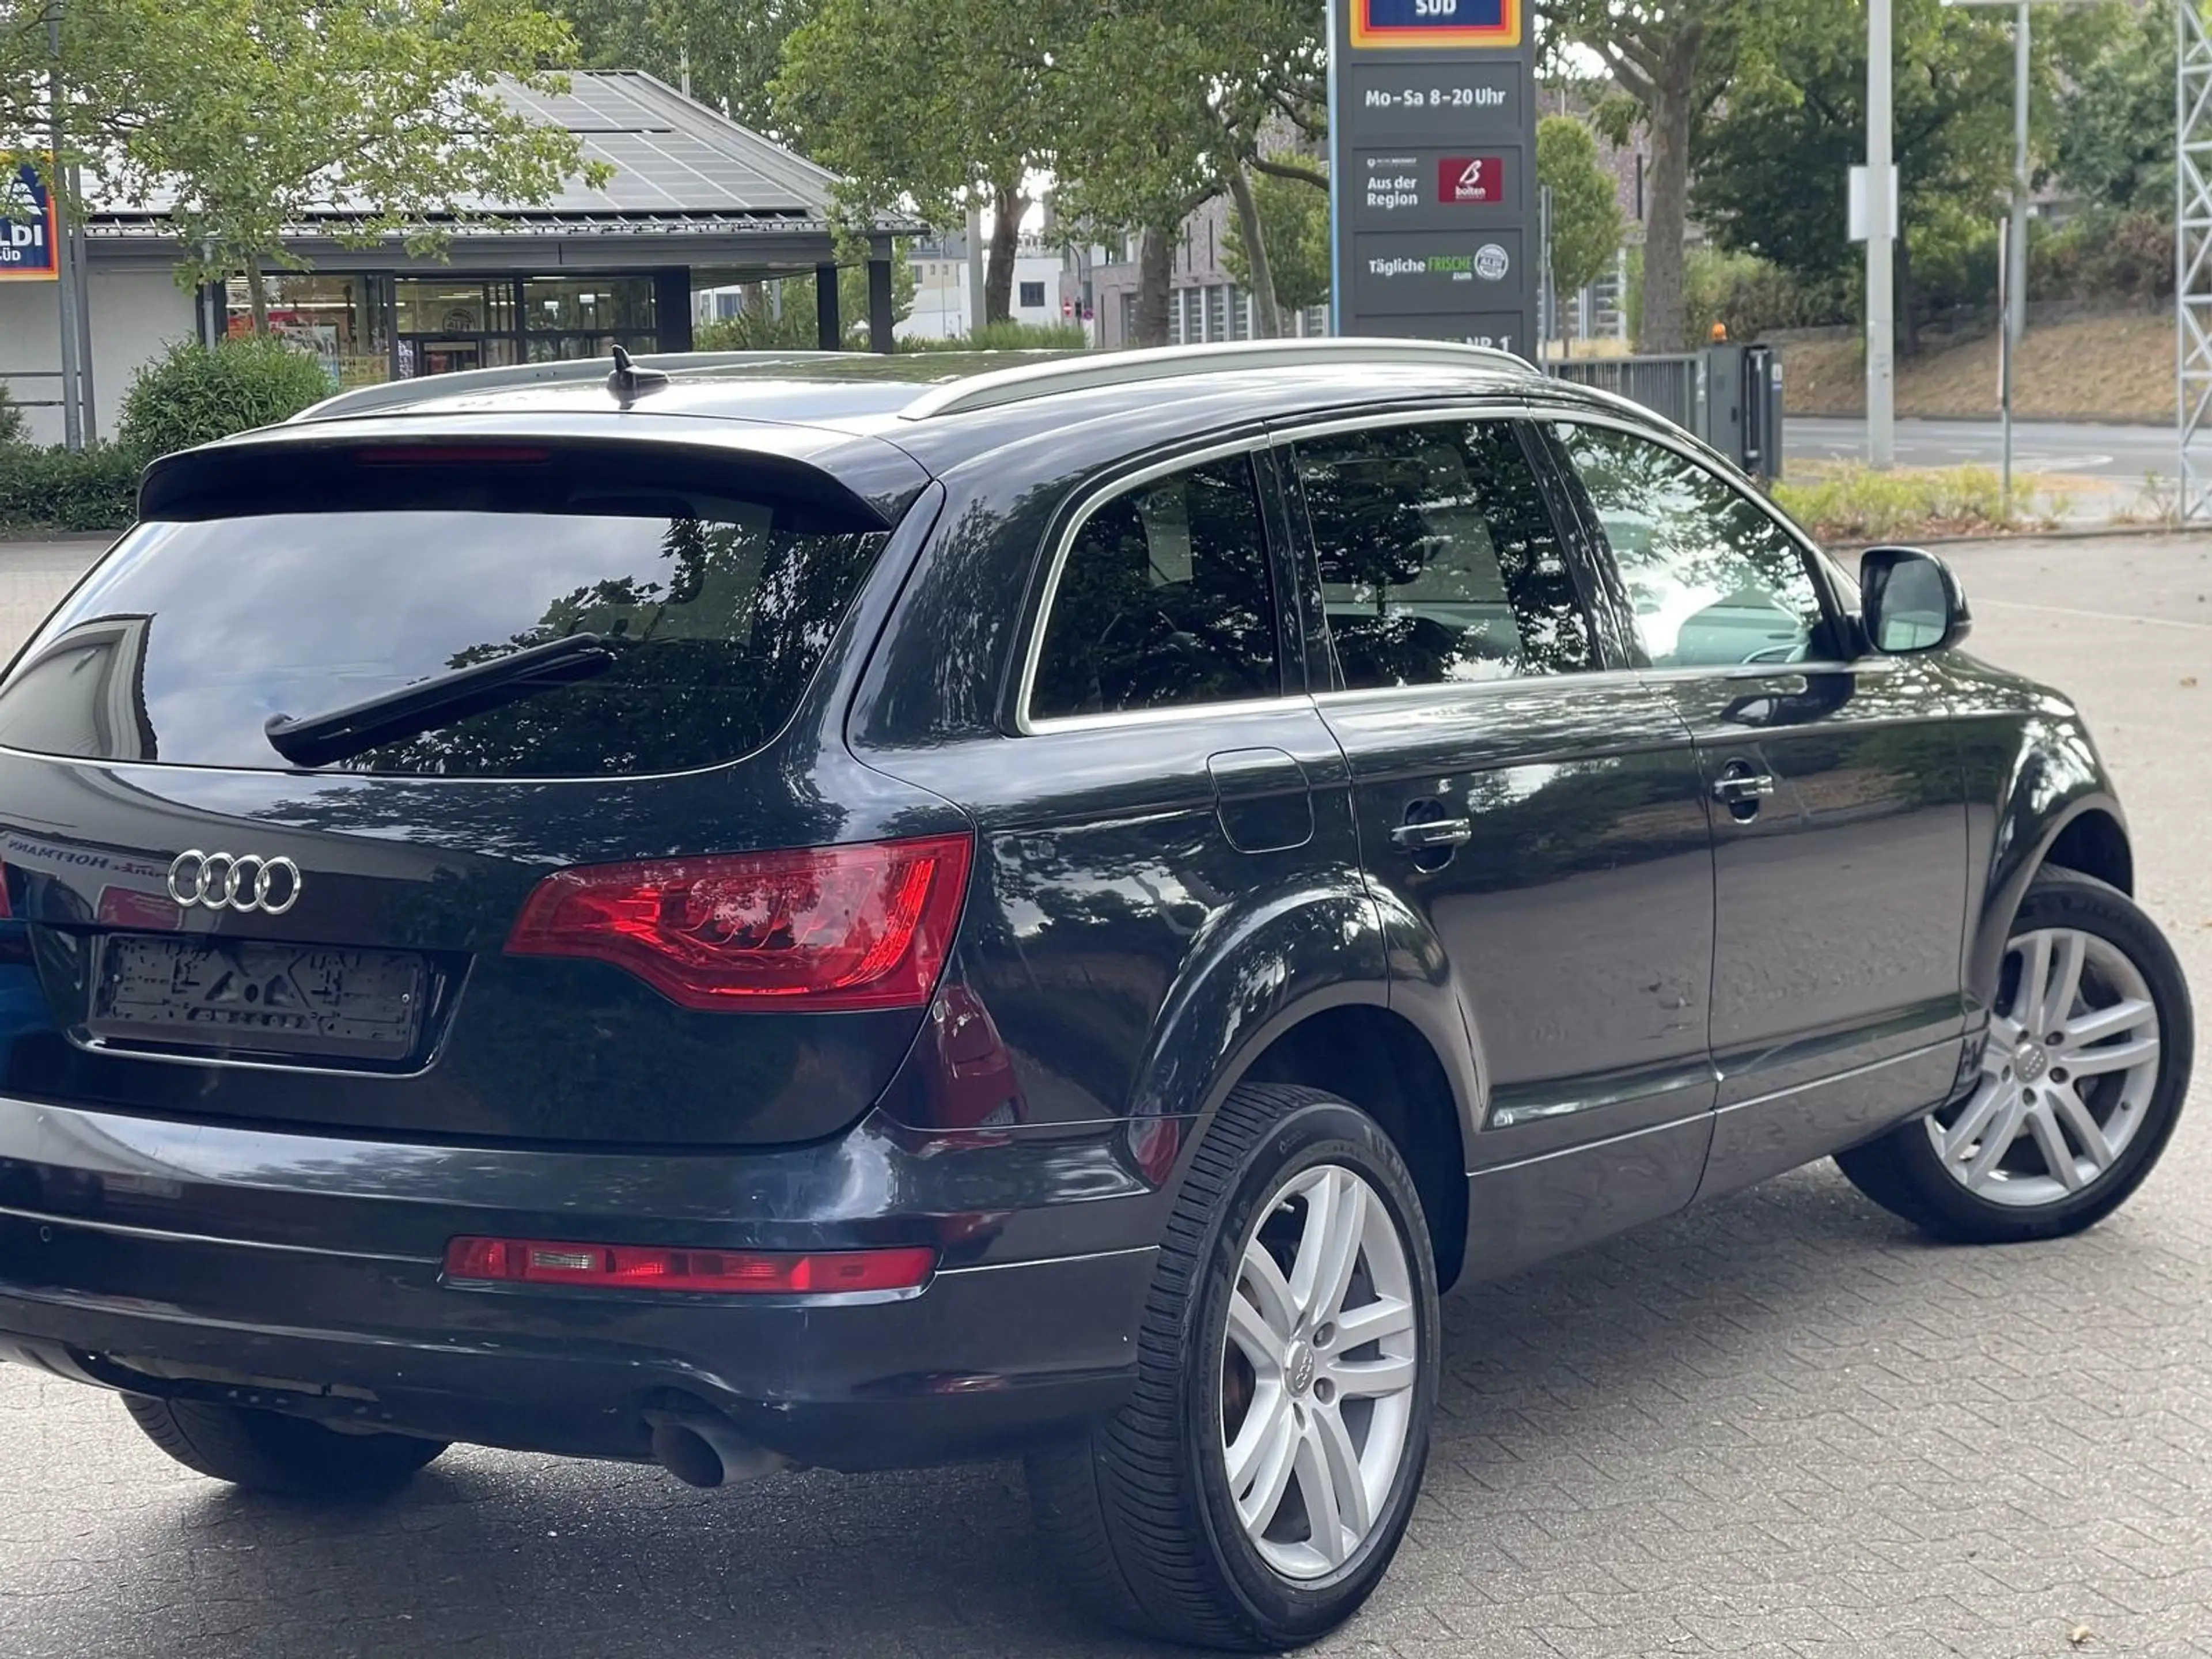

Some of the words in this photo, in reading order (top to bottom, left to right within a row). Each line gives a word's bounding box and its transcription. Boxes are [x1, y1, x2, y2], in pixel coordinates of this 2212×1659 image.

[1475, 86, 1506, 105] Uhr
[1368, 176, 1392, 190] Aus
[1394, 175, 1417, 190] der
[1367, 190, 1418, 210] Region
[0, 247, 21, 261] ÜD
[1369, 258, 1426, 276] Tägliche
[1428, 255, 1472, 271] FRISCHE
